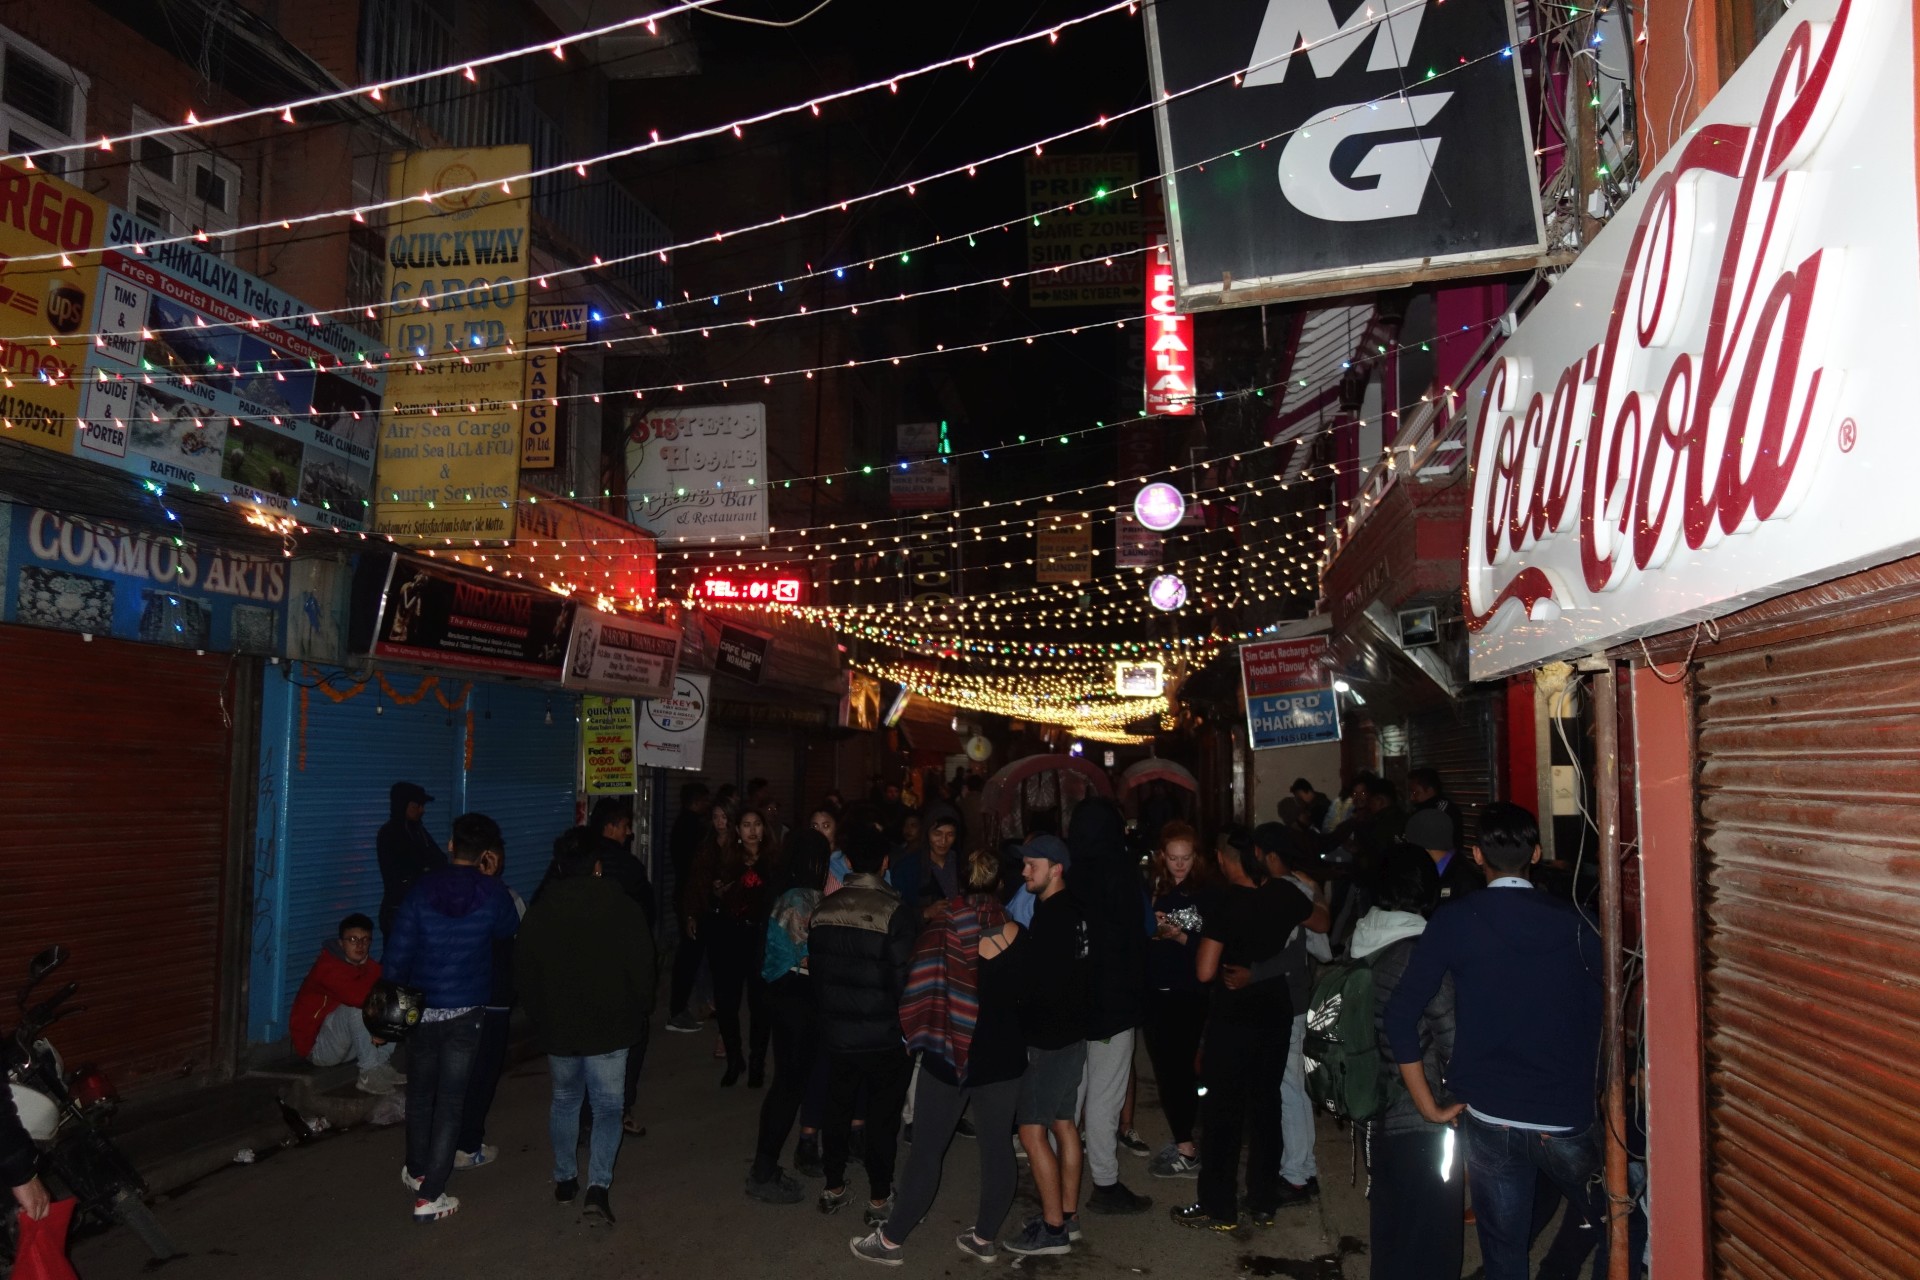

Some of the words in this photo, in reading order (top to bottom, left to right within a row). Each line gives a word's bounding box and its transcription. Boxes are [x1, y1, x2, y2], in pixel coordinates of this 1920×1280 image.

[1028, 155, 1136, 175] INTERNET
[1031, 177, 1123, 196] PRINT
[1031, 198, 1138, 219] PHONE
[1032, 223, 1084, 241] GAME
[1090, 220, 1139, 237] ZONE
[390, 228, 523, 269] QUICKWAY
[1032, 244, 1071, 262] SIM
[1080, 242, 1141, 260] CARD
[110, 213, 156, 258] SAVE
[159, 236, 238, 299] HIMALAYA
[243, 279, 279, 318] Treks
[281, 300, 291, 323] &
[295, 306, 356, 354] Expedition
[1035, 262, 1137, 287] LAUNDRY
[115, 286, 137, 308] TIMS
[121, 259, 156, 284] Free
[160, 276, 206, 308] Tourist
[210, 297, 284, 344] Information
[391, 276, 515, 314] CARGO
[1051, 288, 1078, 301] MSN
[1081, 285, 1121, 300] CYBER
[50, 294, 81, 327] ups
[117, 312, 127, 328] &
[101, 330, 138, 355] PERMIT
[398, 322, 434, 353] (P)
[444, 320, 506, 350] LTD
[405, 362, 444, 376] First
[450, 359, 490, 375] Floor
[96, 378, 128, 401] GUIDE
[166, 374, 216, 402] TREKKING
[529, 355, 547, 435] CARGO
[104, 404, 112, 419] &
[239, 400, 297, 431] PARAGLING
[394, 400, 456, 416] Remember
[86, 423, 125, 447] PORTER
[385, 422, 451, 440] Air/Sea
[458, 420, 511, 439] Cargo
[314, 430, 334, 447] PEAK
[335, 438, 370, 461] CLIMBING
[384, 443, 419, 459] Land
[526, 438, 536, 453] (P)
[150, 460, 196, 483] RAFTING
[440, 463, 449, 479] &
[232, 485, 264, 501] SAFARI
[265, 495, 288, 511] TOUR
[381, 486, 440, 502] Courier
[721, 490, 757, 508] Bar
[330, 515, 357, 530] FLIGHT
[676, 511, 690, 525] &
[693, 510, 758, 525] Restaurant
[378, 523, 412, 535] Customer's
[414, 520, 453, 536] Satisfaction
[28, 507, 198, 589] COSMOS
[204, 550, 286, 603] ARTS
[1040, 563, 1087, 572] LAUNDRY
[705, 580, 739, 598] TEL.
[453, 579, 533, 625] NIRVANA
[449, 616, 464, 626] The
[466, 619, 507, 634] Handicraft
[509, 625, 528, 637] Store
[719, 640, 741, 658] CAFE
[741, 650, 762, 665] WITH
[1245, 651, 1258, 662] Sim
[1260, 650, 1277, 661] Card,
[1277, 646, 1309, 659] Recharge
[736, 657, 752, 671] NAME
[1250, 662, 1277, 676] Hookah
[1278, 660, 1307, 673] Flavour,
[1263, 695, 1320, 713] LORD
[1253, 709, 1334, 733] PHARMACY
[1275, 732, 1315, 743] INSIDE
[588, 747, 615, 756] FedEx
